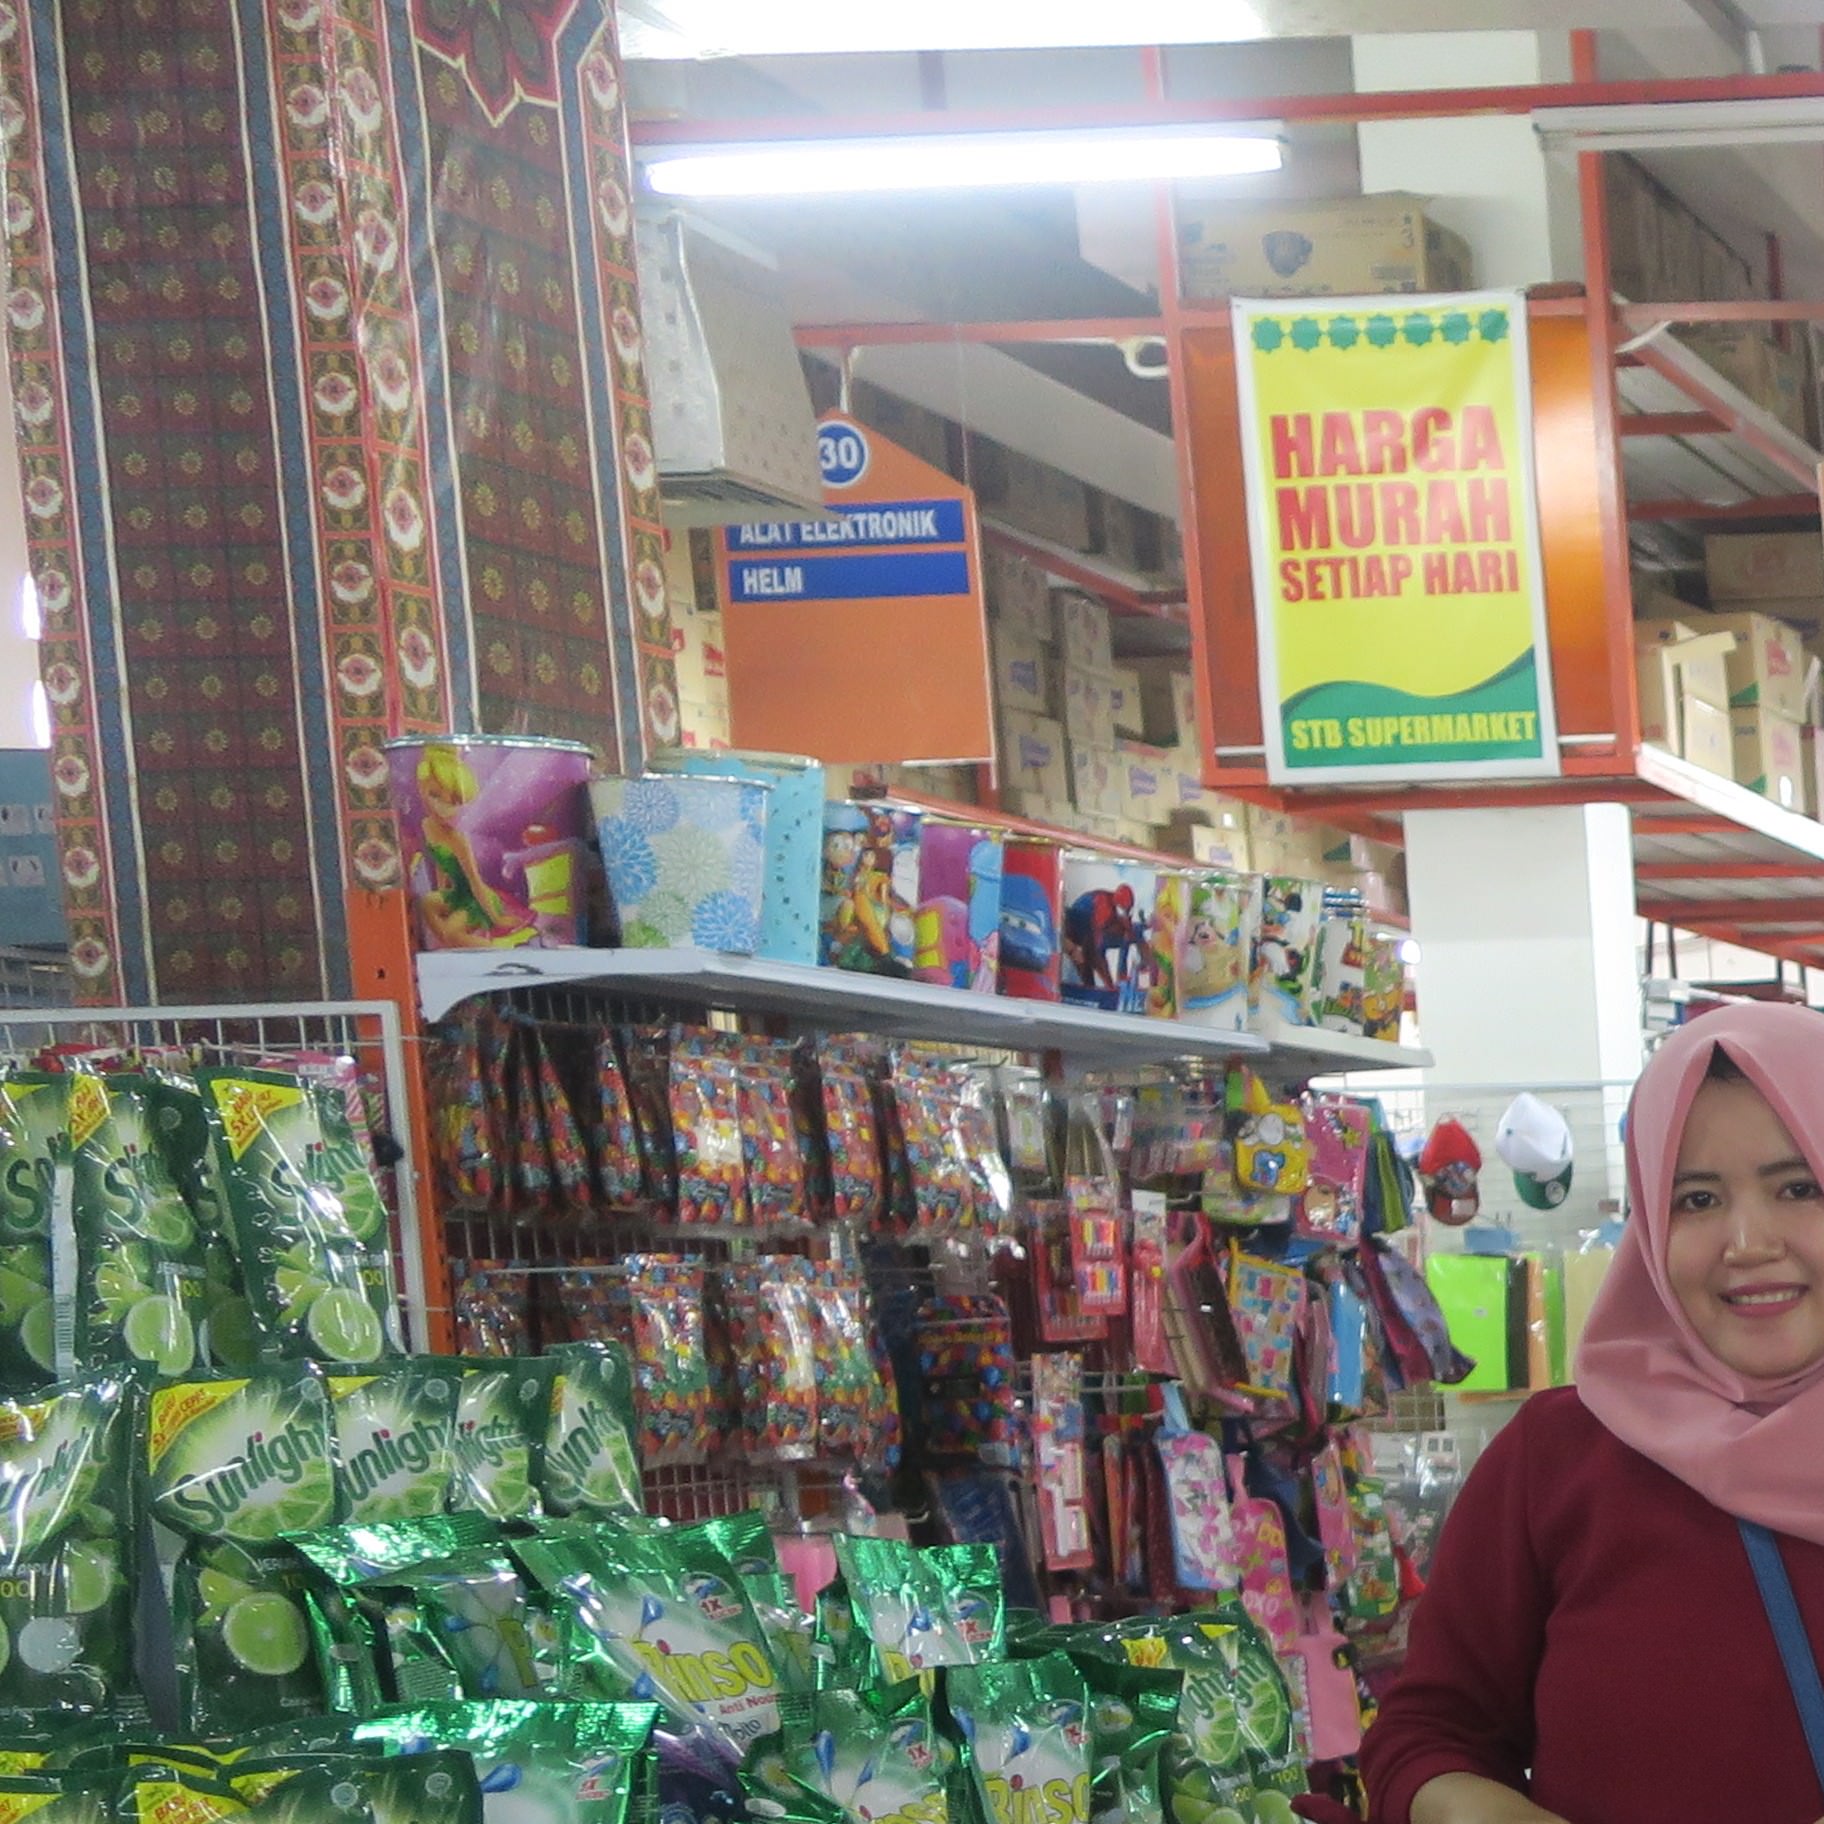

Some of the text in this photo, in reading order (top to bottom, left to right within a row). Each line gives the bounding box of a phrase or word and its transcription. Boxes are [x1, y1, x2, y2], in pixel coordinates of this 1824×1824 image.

[819, 436, 857, 470] 30
[1270, 406, 1504, 478] HARGA
[801, 510, 938, 541] ELEKTRONIK
[1276, 478, 1511, 550] MURAH
[743, 567, 802, 594] HELM
[1280, 550, 1519, 602] SETIAP HARI
[1291, 712, 1536, 749] STB SUPERMARKET
